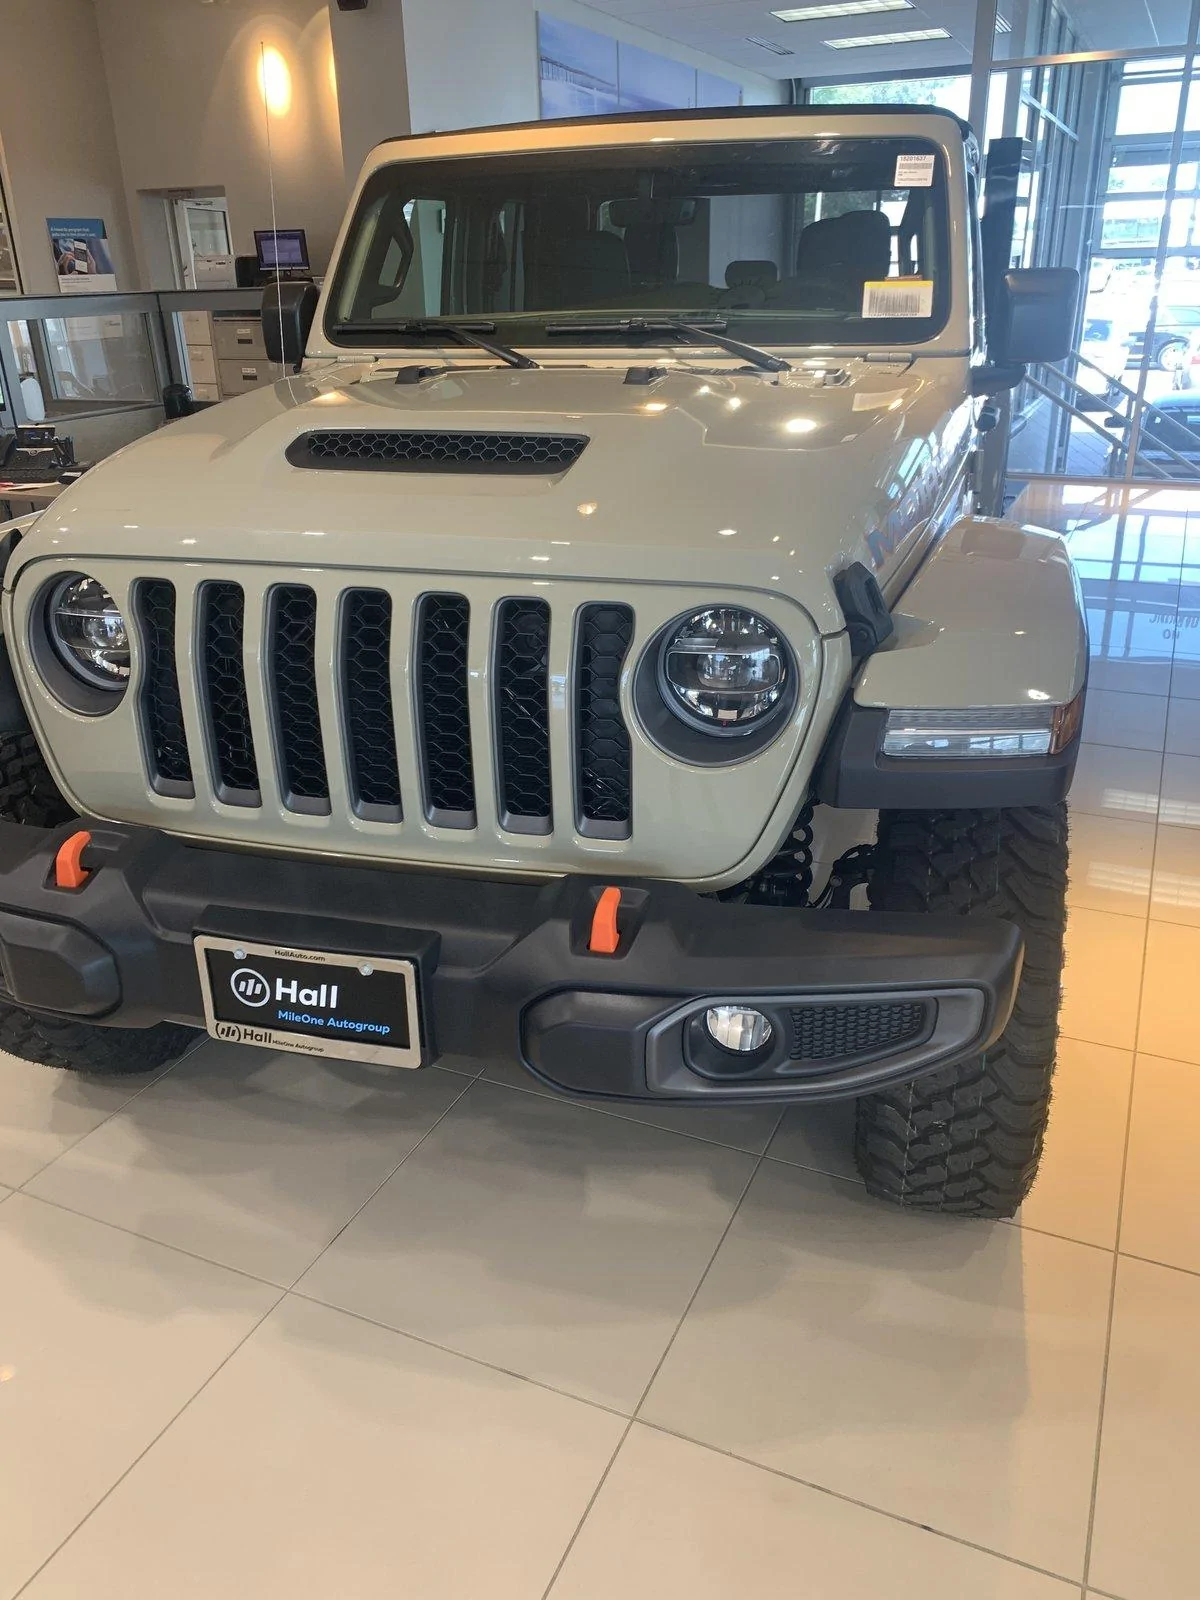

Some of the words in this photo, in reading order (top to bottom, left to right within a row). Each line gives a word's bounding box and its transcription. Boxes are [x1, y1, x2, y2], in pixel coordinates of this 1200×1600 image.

[274, 949, 326, 962] HallAuto.com
[275, 977, 338, 1009] Hall
[278, 1009, 324, 1026] MileOne
[327, 1016, 391, 1035] Autogroup
[243, 1028, 272, 1044] Hall
